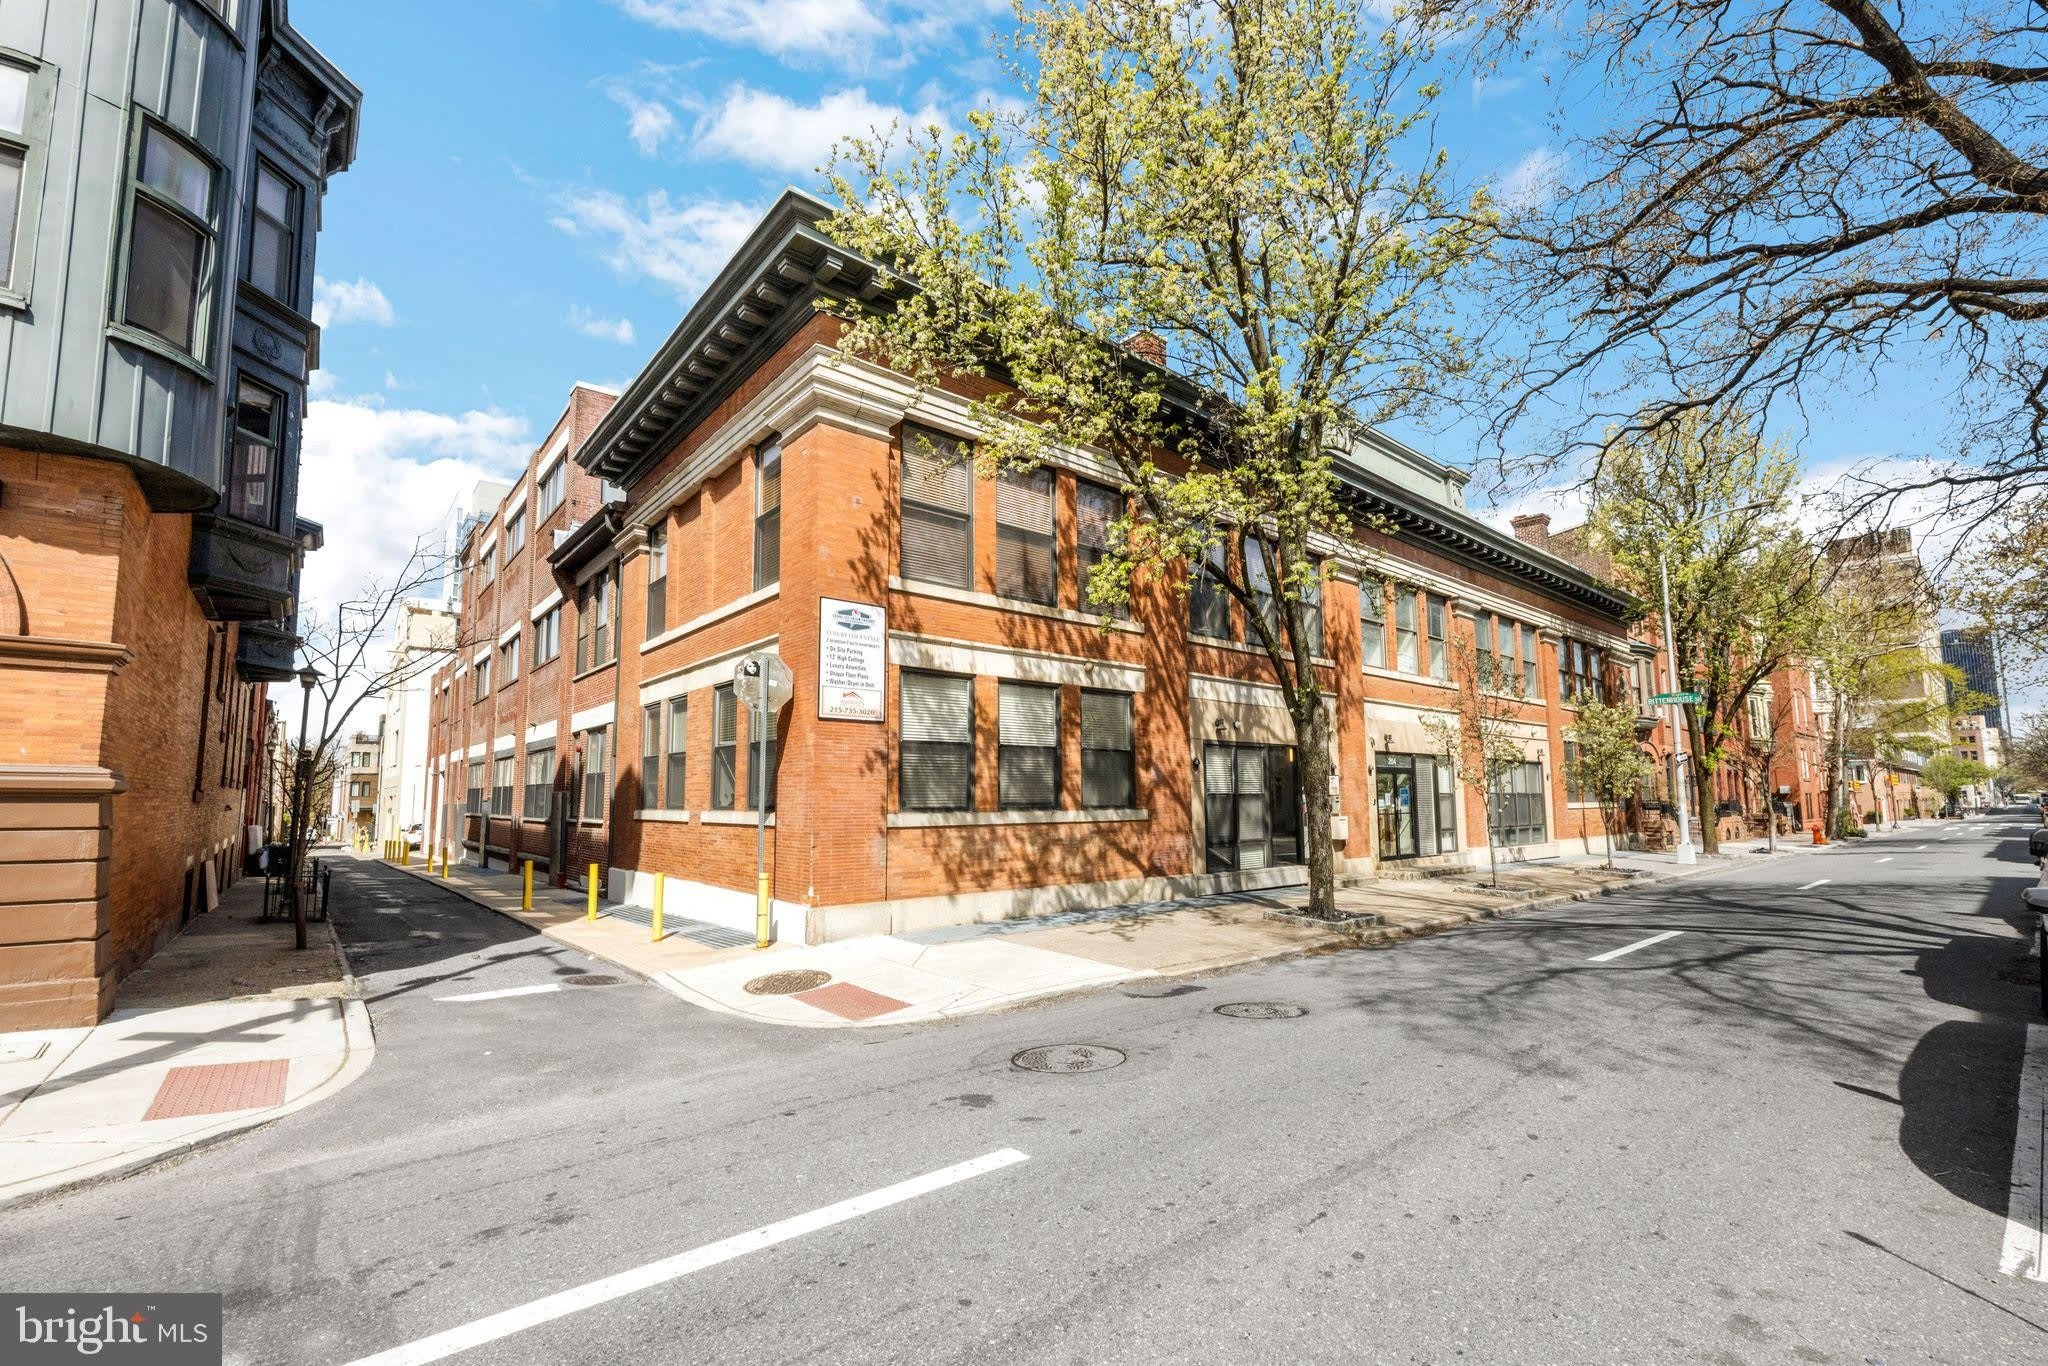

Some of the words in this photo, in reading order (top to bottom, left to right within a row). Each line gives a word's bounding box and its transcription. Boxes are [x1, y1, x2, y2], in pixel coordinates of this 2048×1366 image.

[837, 646, 846, 654] Site
[847, 647, 863, 657] Parking
[837, 655, 847, 663] High
[848, 655, 865, 664] Ceilings
[830, 661, 845, 670] Luxury
[846, 663, 867, 672] Amenities
[830, 670, 845, 679] Unique
[845, 671, 857, 679] Floor
[857, 672, 869, 680] Plans
[830, 678, 846, 686] Washer
[865, 681, 875, 689] Unit
[1648, 696, 1693, 705] RITTENHOUSE
[830, 706, 875, 715] 215-735-3020
